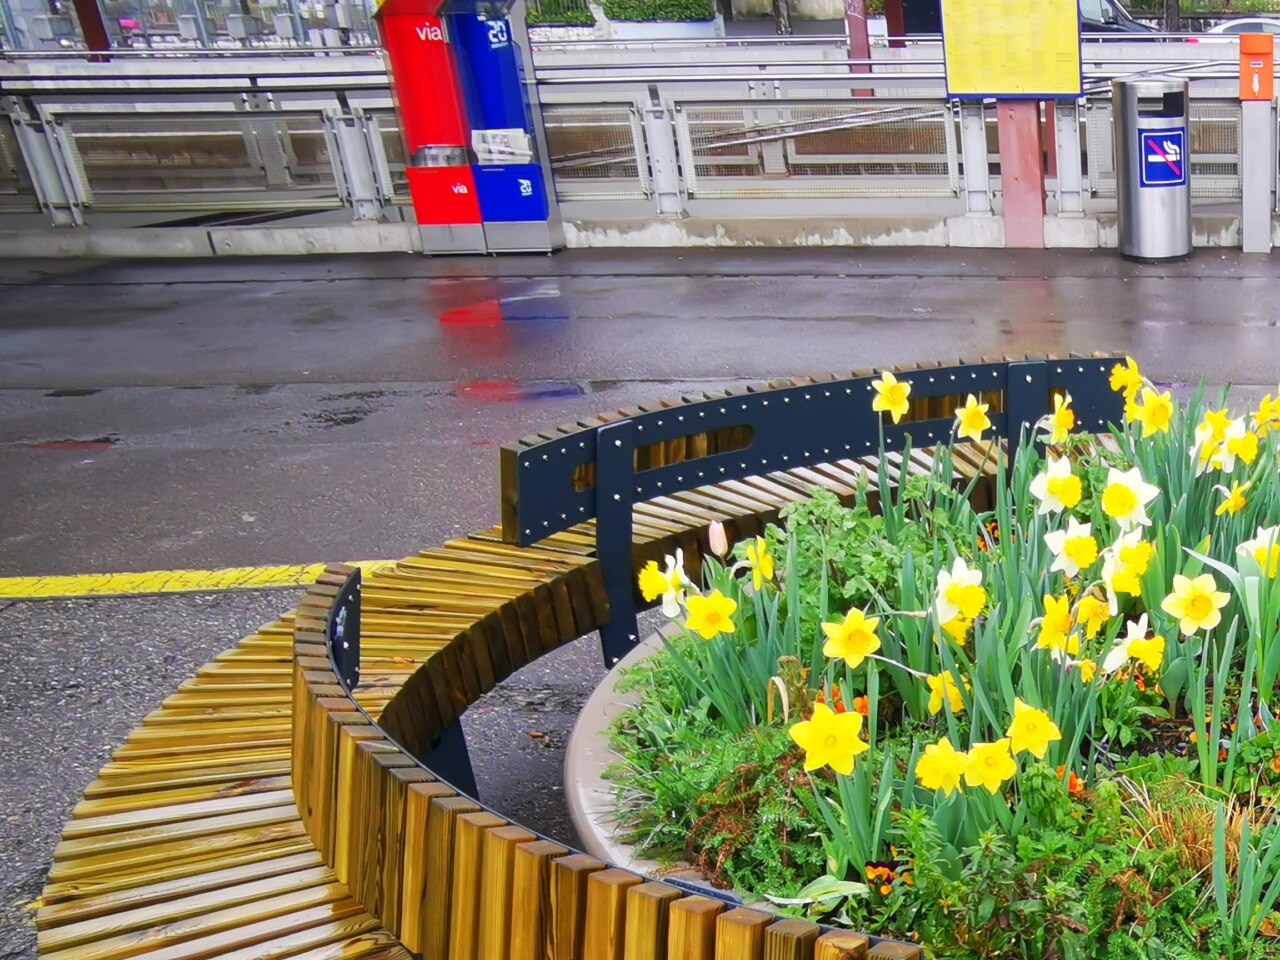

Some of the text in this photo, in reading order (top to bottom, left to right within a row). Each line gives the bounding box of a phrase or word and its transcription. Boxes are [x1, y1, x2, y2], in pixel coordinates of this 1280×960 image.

[415, 21, 443, 41] via
[487, 20, 508, 43] 20
[451, 182, 468, 194] via
